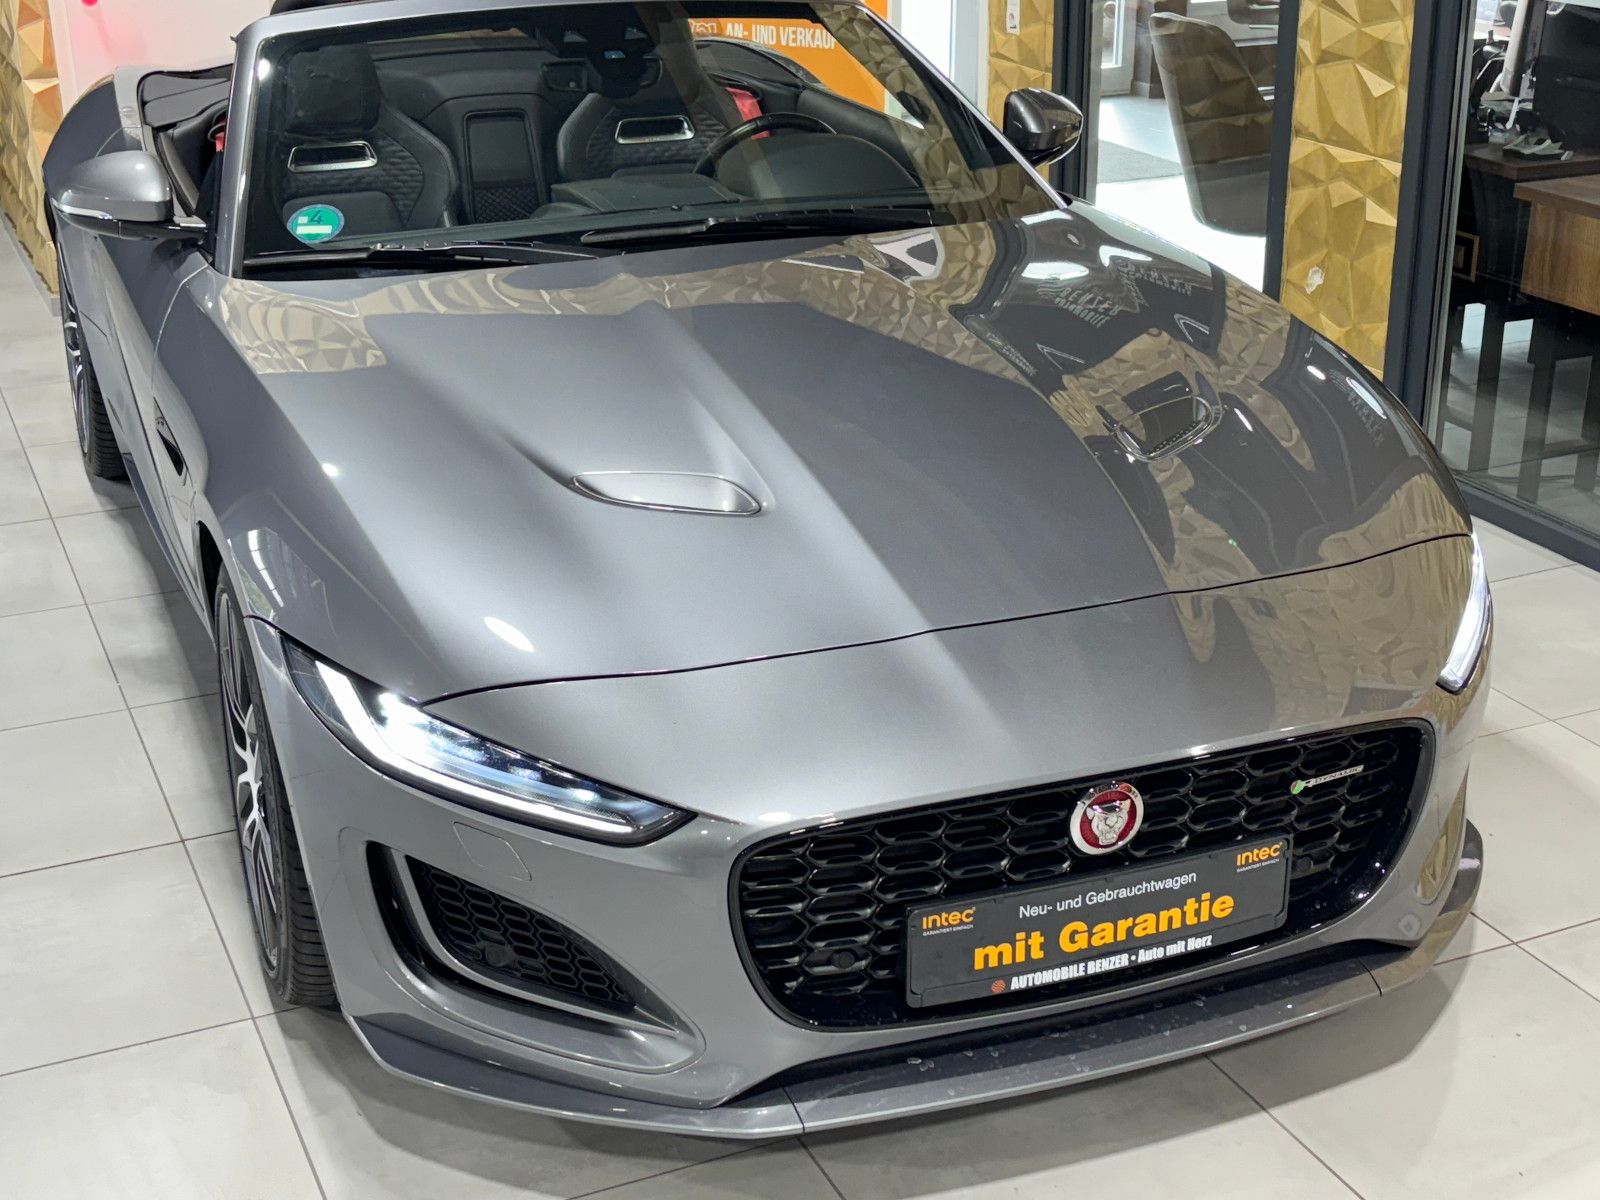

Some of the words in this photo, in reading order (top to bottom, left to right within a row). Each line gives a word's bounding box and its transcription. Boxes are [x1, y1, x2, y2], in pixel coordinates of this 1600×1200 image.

[726, 22, 748, 39] AN-
[752, 24, 776, 45] UND
[310, 210, 323, 225] 4
[1019, 903, 1053, 919] Neu-
[1057, 894, 1082, 912] und
[1085, 872, 1197, 905] Gebrauchtwagen
[974, 931, 1045, 970] mit
[1058, 892, 1235, 953] Garantie
[1010, 961, 1086, 990] AUTOMOBILE
[1087, 952, 1129, 976] BENZER
[1137, 946, 1164, 963] Auto
[1166, 940, 1186, 956] mit
[1187, 934, 1213, 951] Herz
